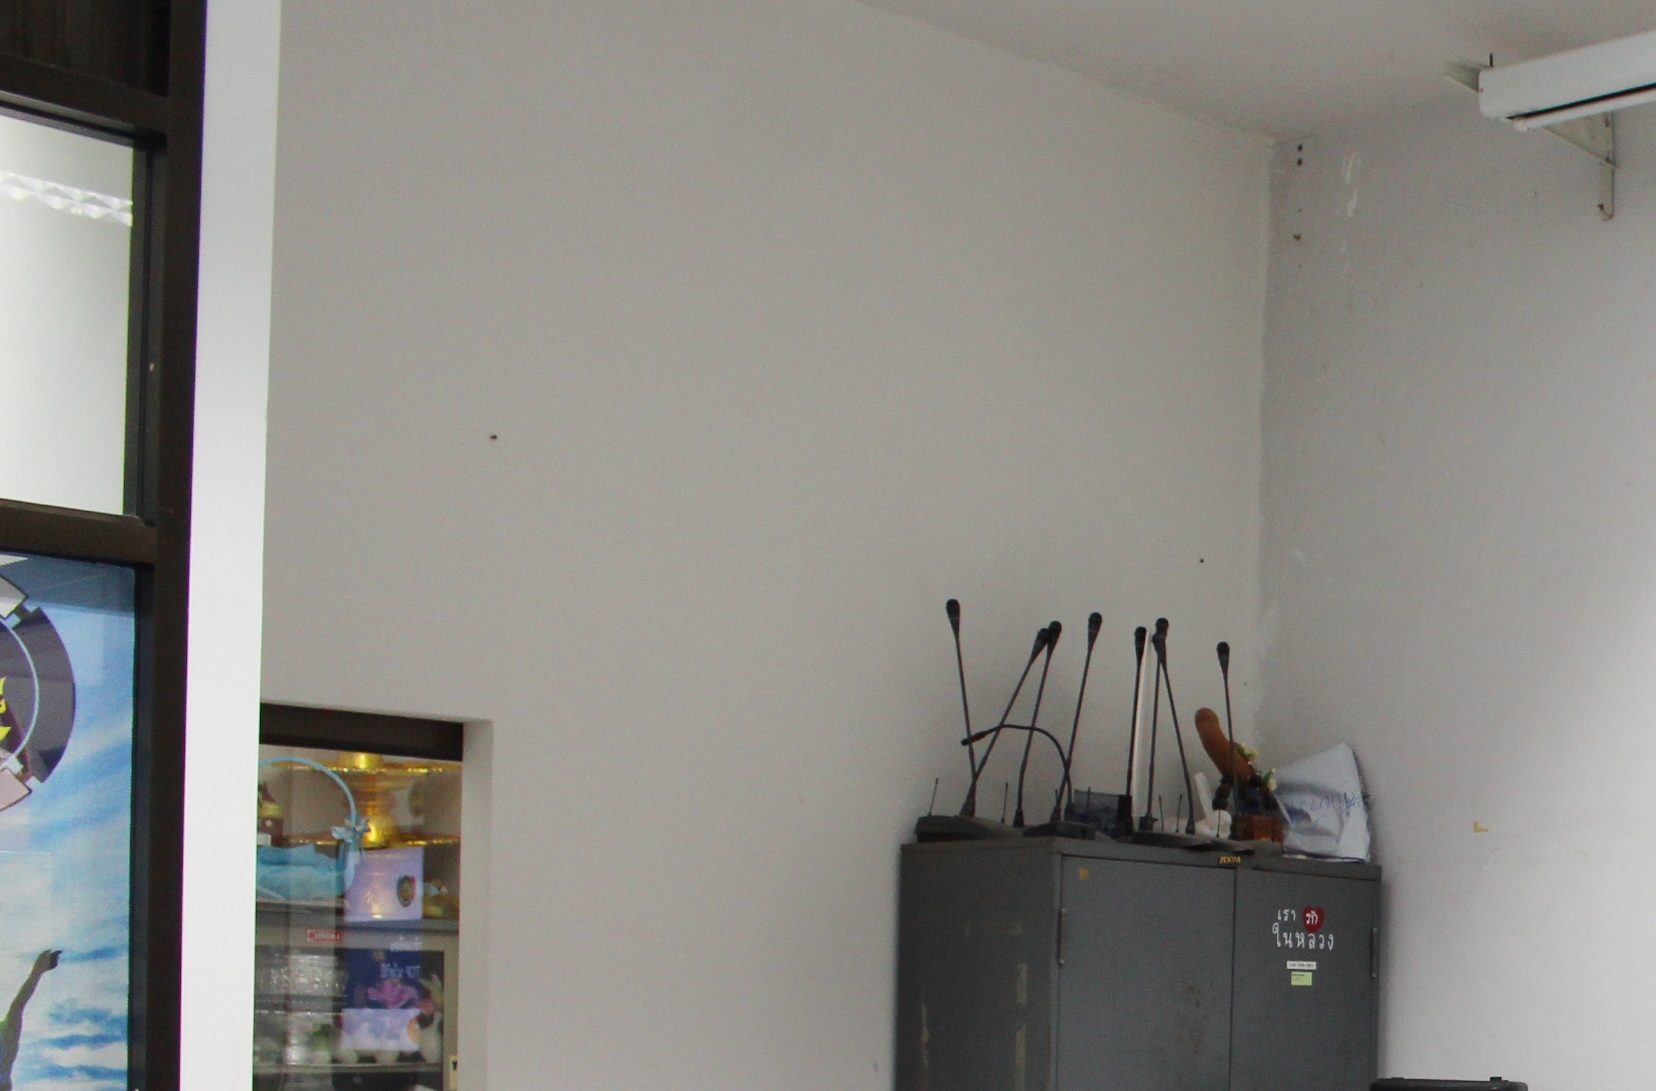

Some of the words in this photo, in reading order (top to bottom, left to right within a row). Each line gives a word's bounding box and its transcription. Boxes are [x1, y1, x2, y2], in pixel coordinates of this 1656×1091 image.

[1277, 909, 1297, 921] เรา
[1271, 922, 1335, 950] ในหลวง
